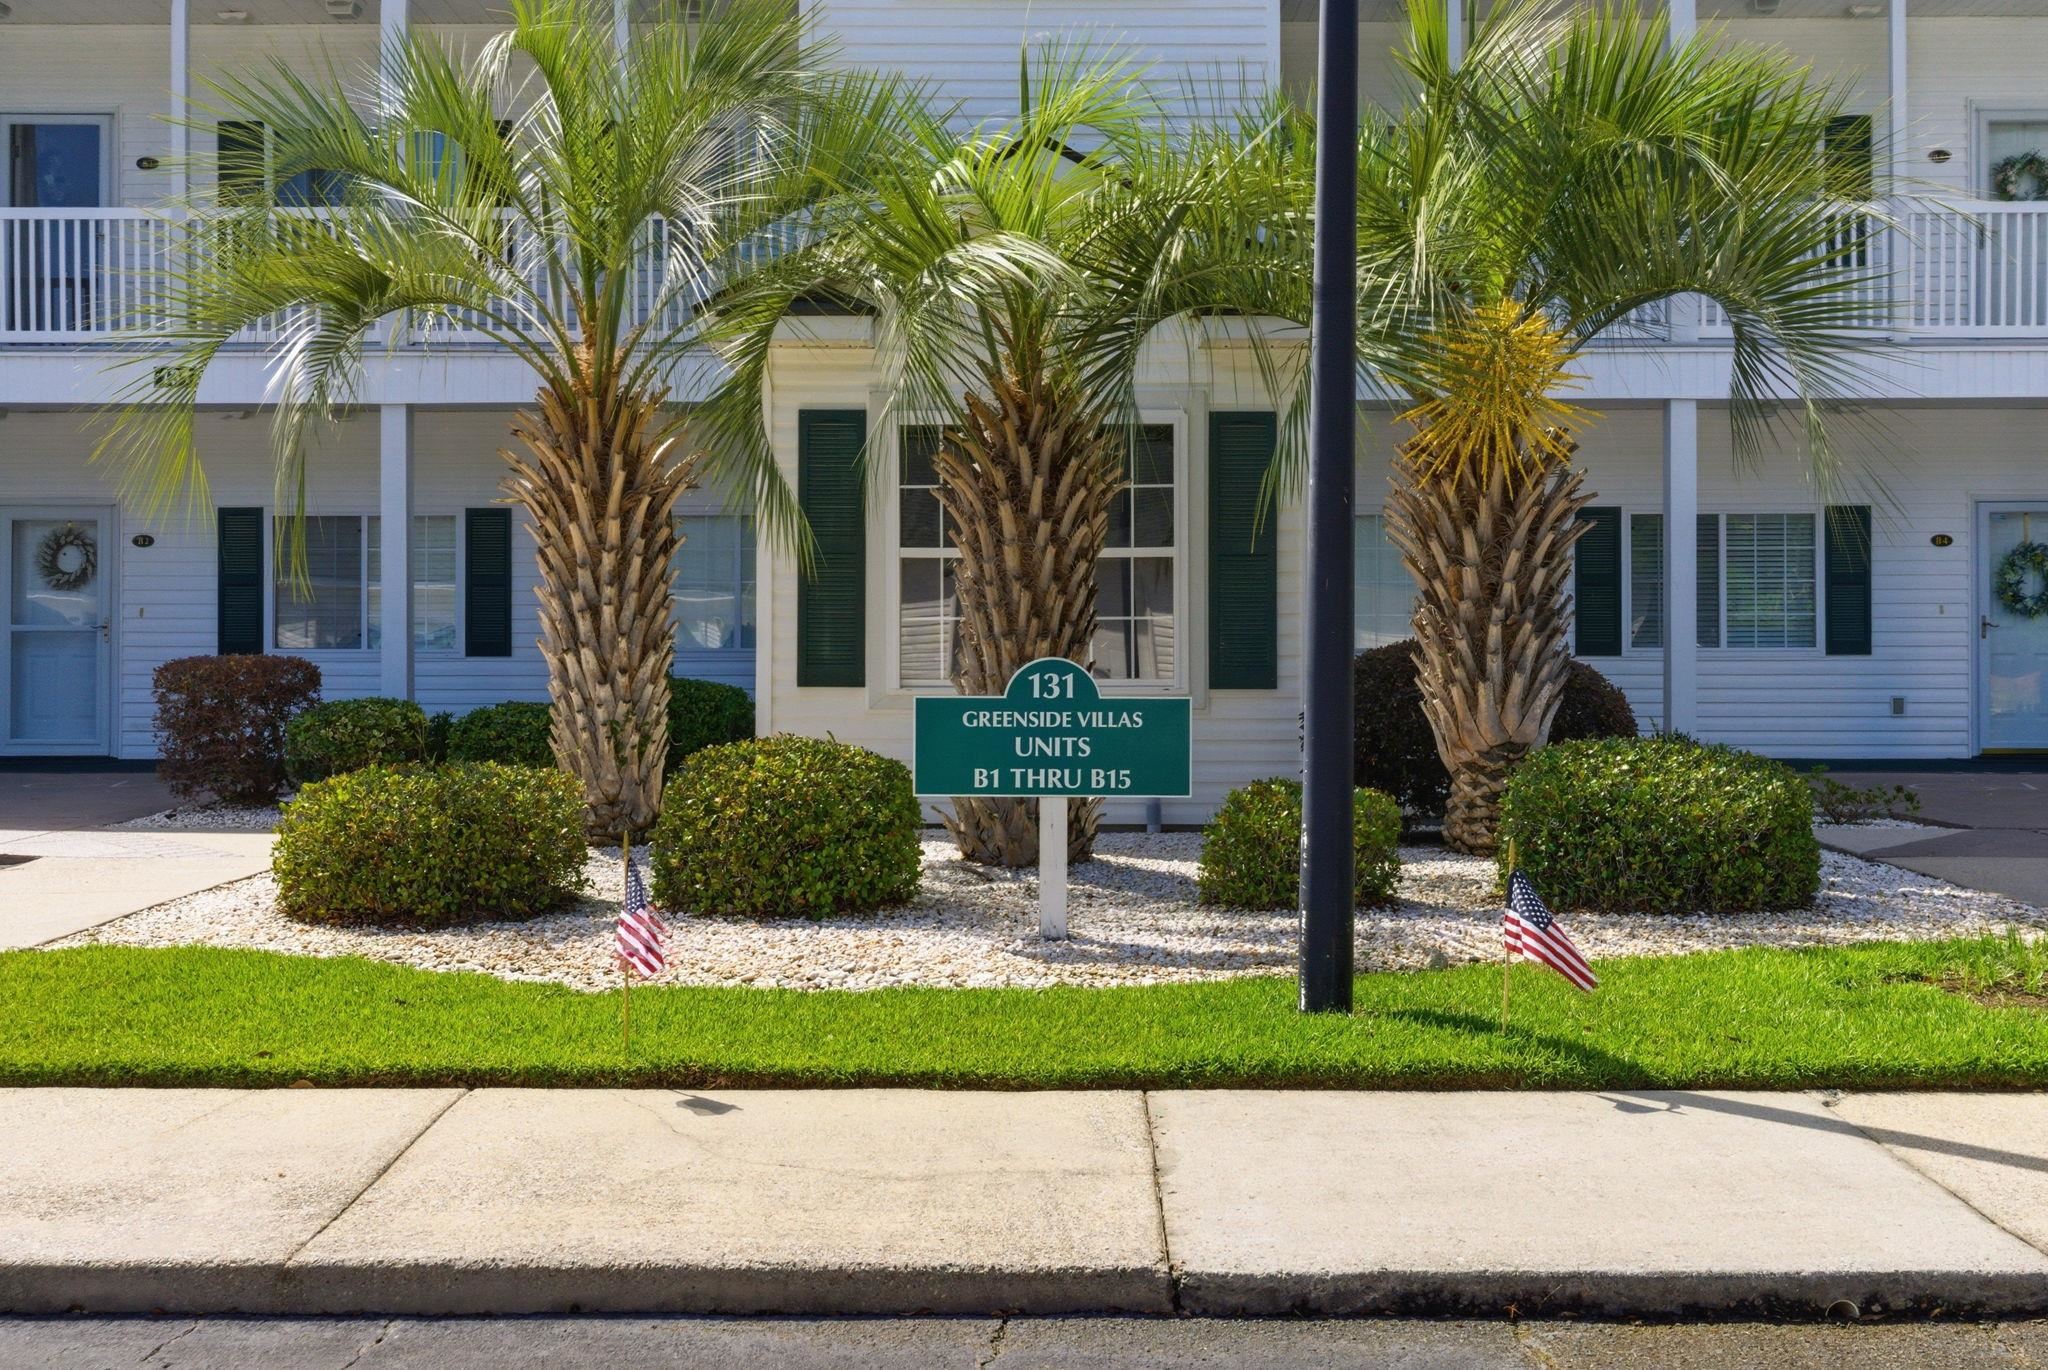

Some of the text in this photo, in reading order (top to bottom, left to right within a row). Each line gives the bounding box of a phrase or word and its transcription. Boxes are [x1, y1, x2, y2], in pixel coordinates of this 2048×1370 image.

[1028, 672, 1074, 699] 131
[962, 711, 1143, 728] GREENSIDE VILLAS
[1015, 736, 1091, 757] UNITS
[973, 768, 1131, 788] B1 THRU B15
